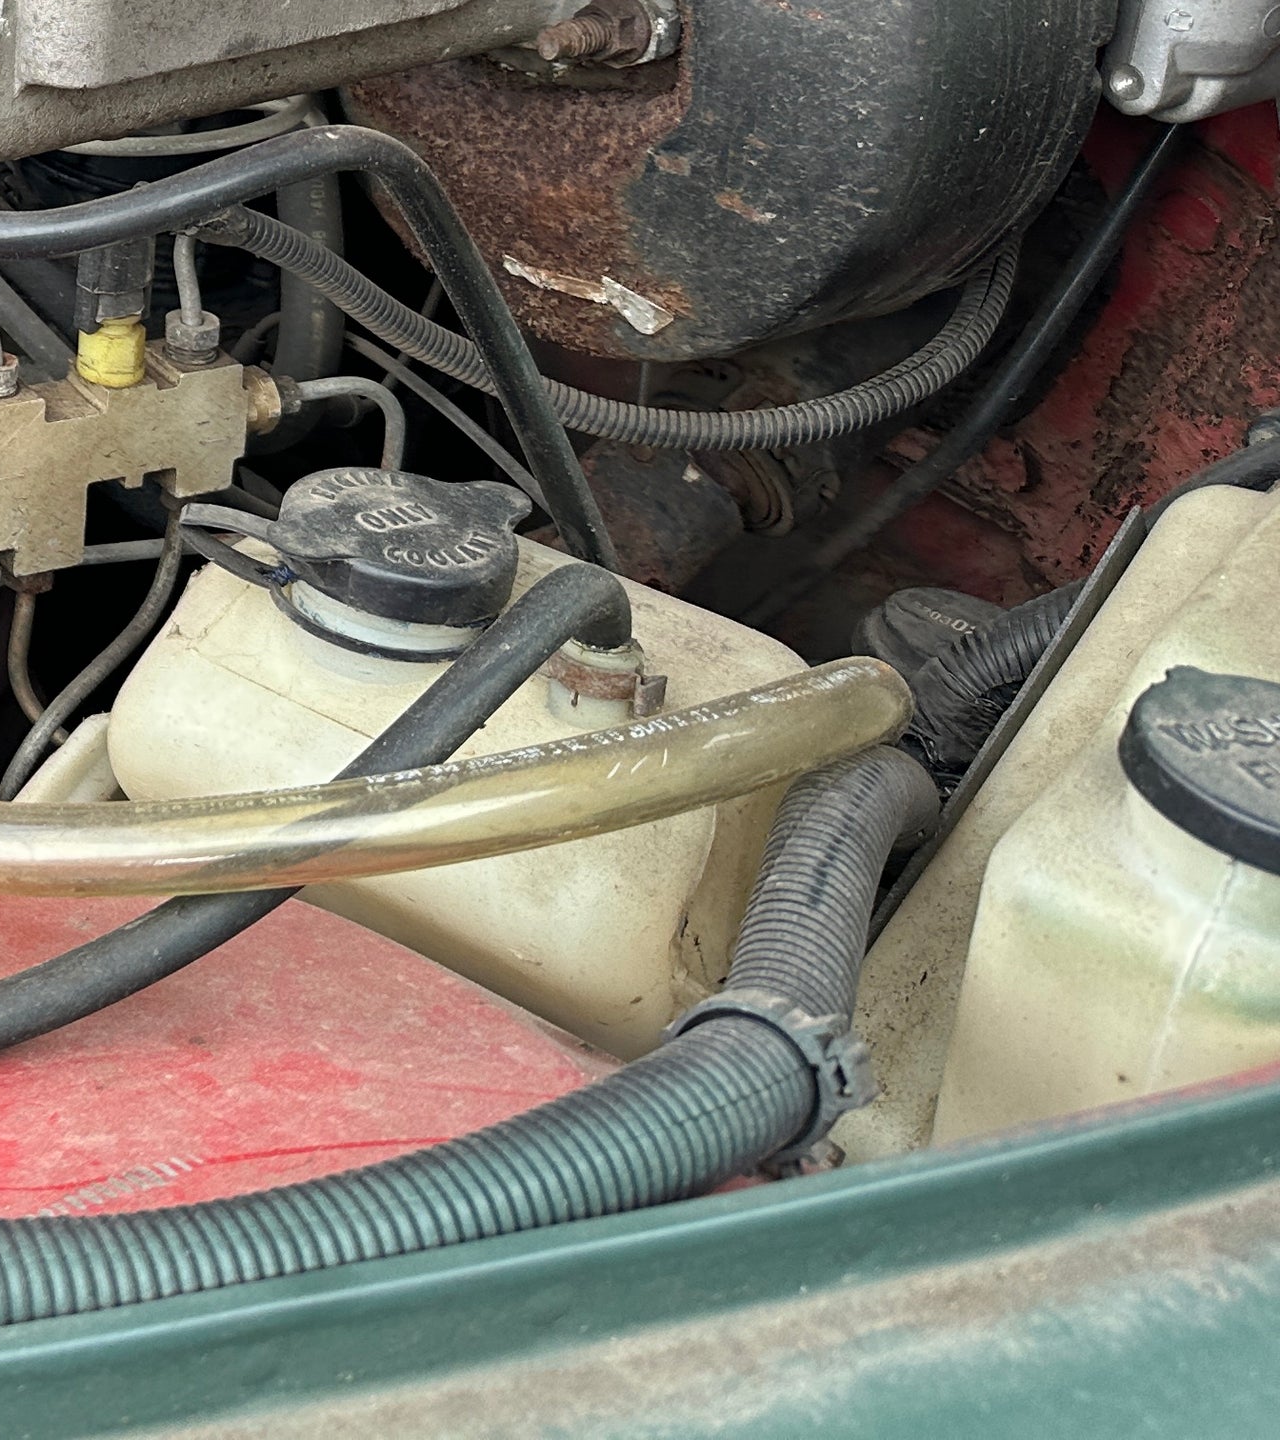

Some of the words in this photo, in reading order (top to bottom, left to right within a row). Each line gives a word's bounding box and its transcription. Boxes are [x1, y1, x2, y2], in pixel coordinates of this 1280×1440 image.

[308, 469, 406, 503] ENGINE
[356, 501, 438, 534] ONLY
[382, 530, 500, 567] COOLANT
